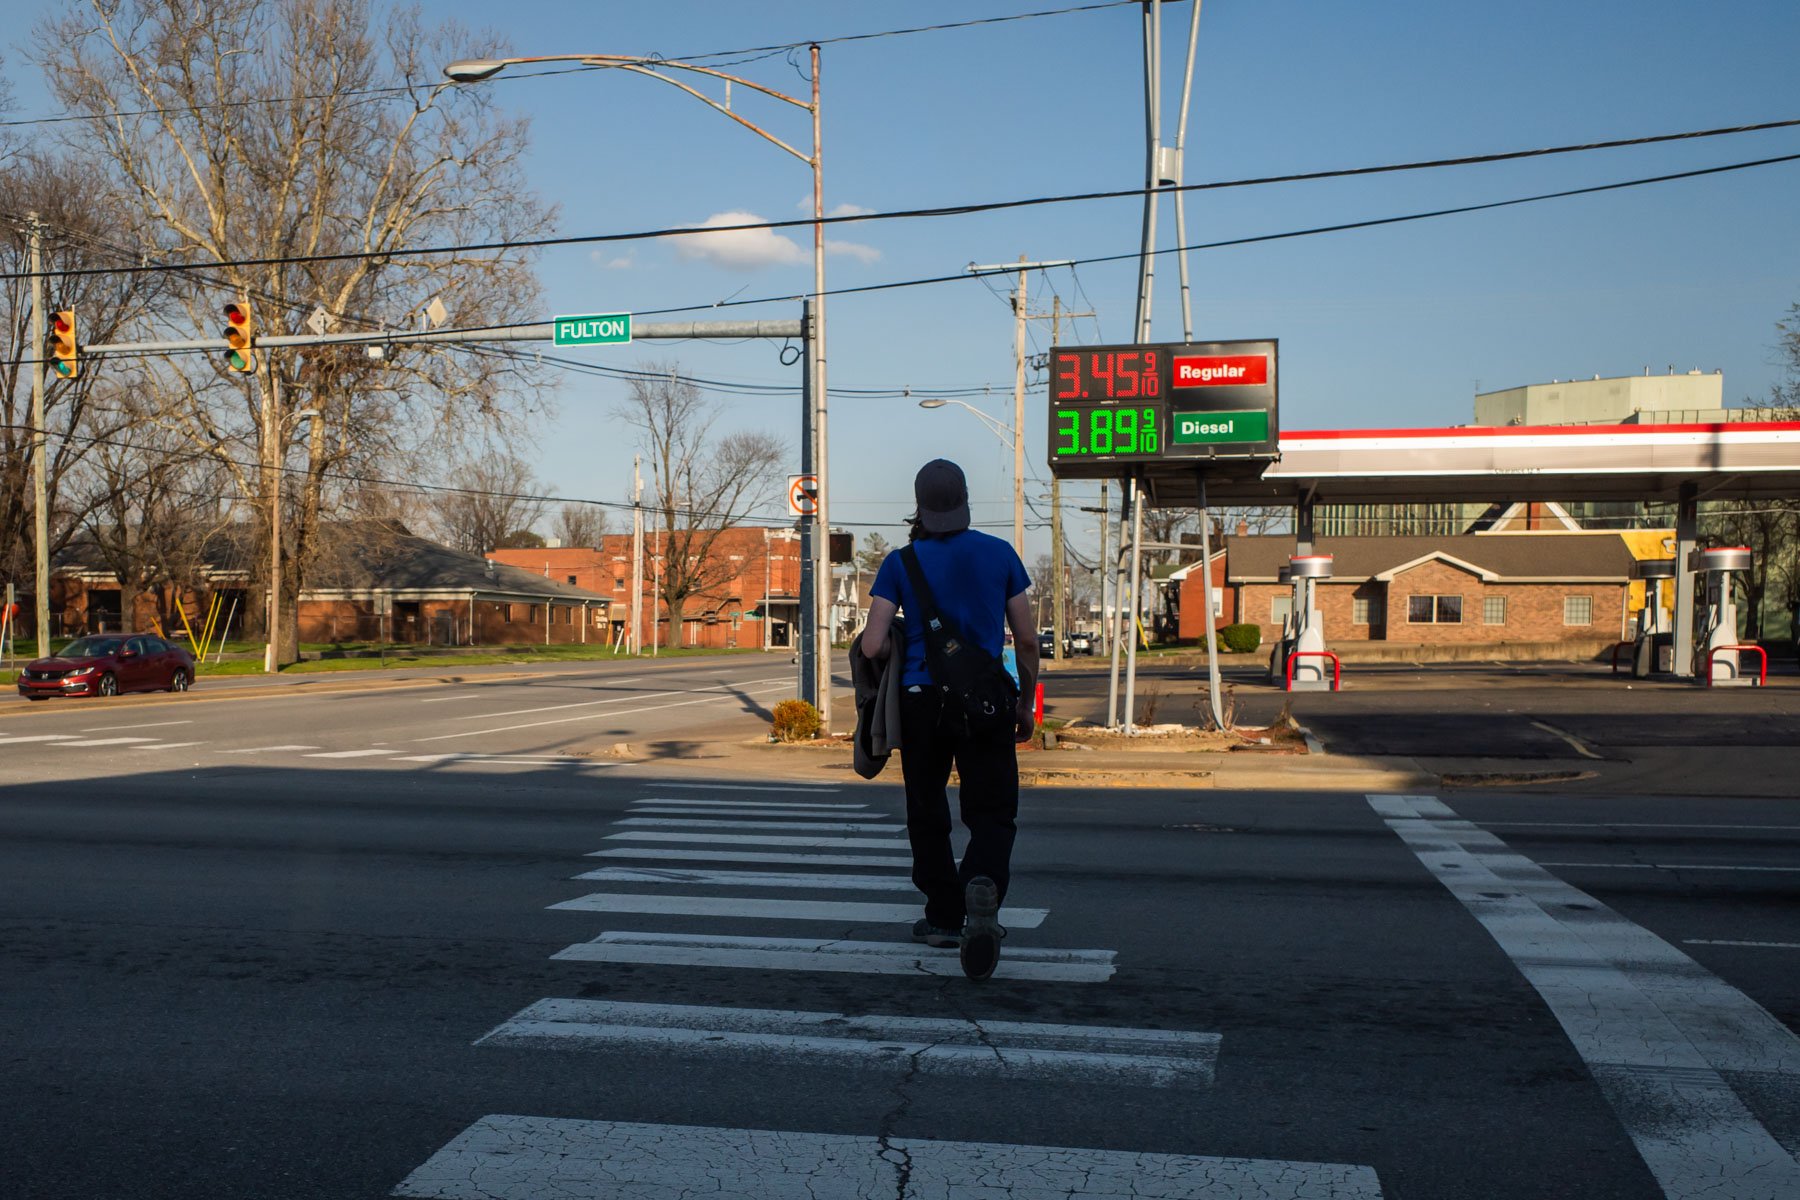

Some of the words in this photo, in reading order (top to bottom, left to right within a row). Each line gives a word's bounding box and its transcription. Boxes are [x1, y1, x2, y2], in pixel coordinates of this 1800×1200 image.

[560, 320, 625, 339] FULTON
[1058, 352, 1139, 398] 3.45
[1180, 364, 1246, 380] Regular
[1057, 409, 1138, 455] 3.89
[1181, 420, 1234, 435] Diesel
